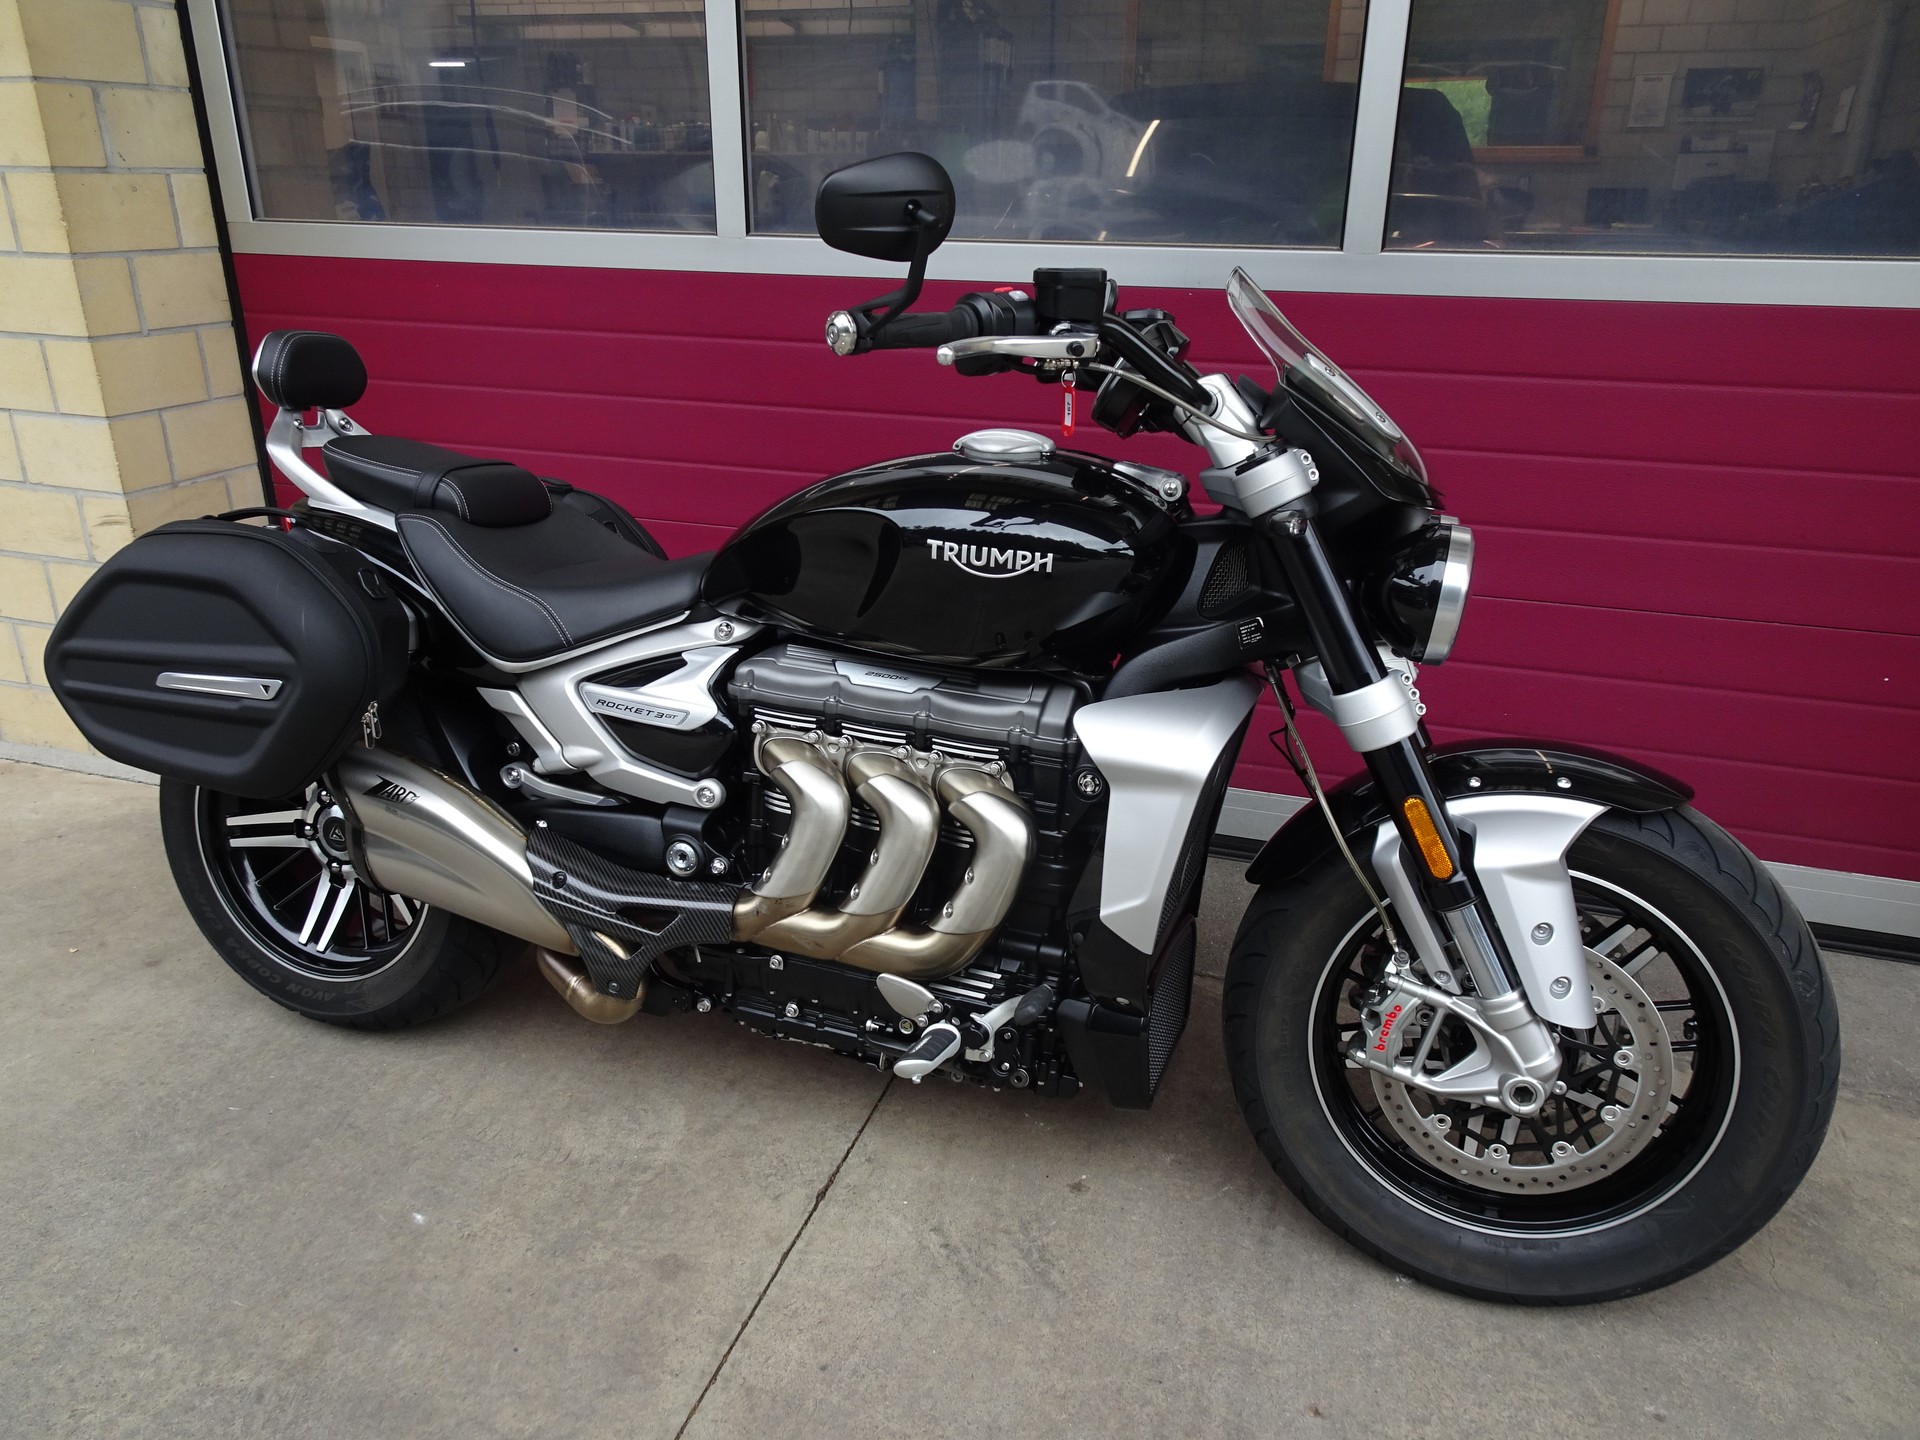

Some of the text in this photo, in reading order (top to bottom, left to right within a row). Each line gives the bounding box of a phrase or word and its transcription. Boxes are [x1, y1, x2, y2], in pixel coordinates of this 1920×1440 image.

[926, 538, 1054, 579] TRIUMPH
[596, 698, 655, 717] ROCKET
[285, 982, 337, 1001] AVON
[1373, 1005, 1403, 1051] brembo
